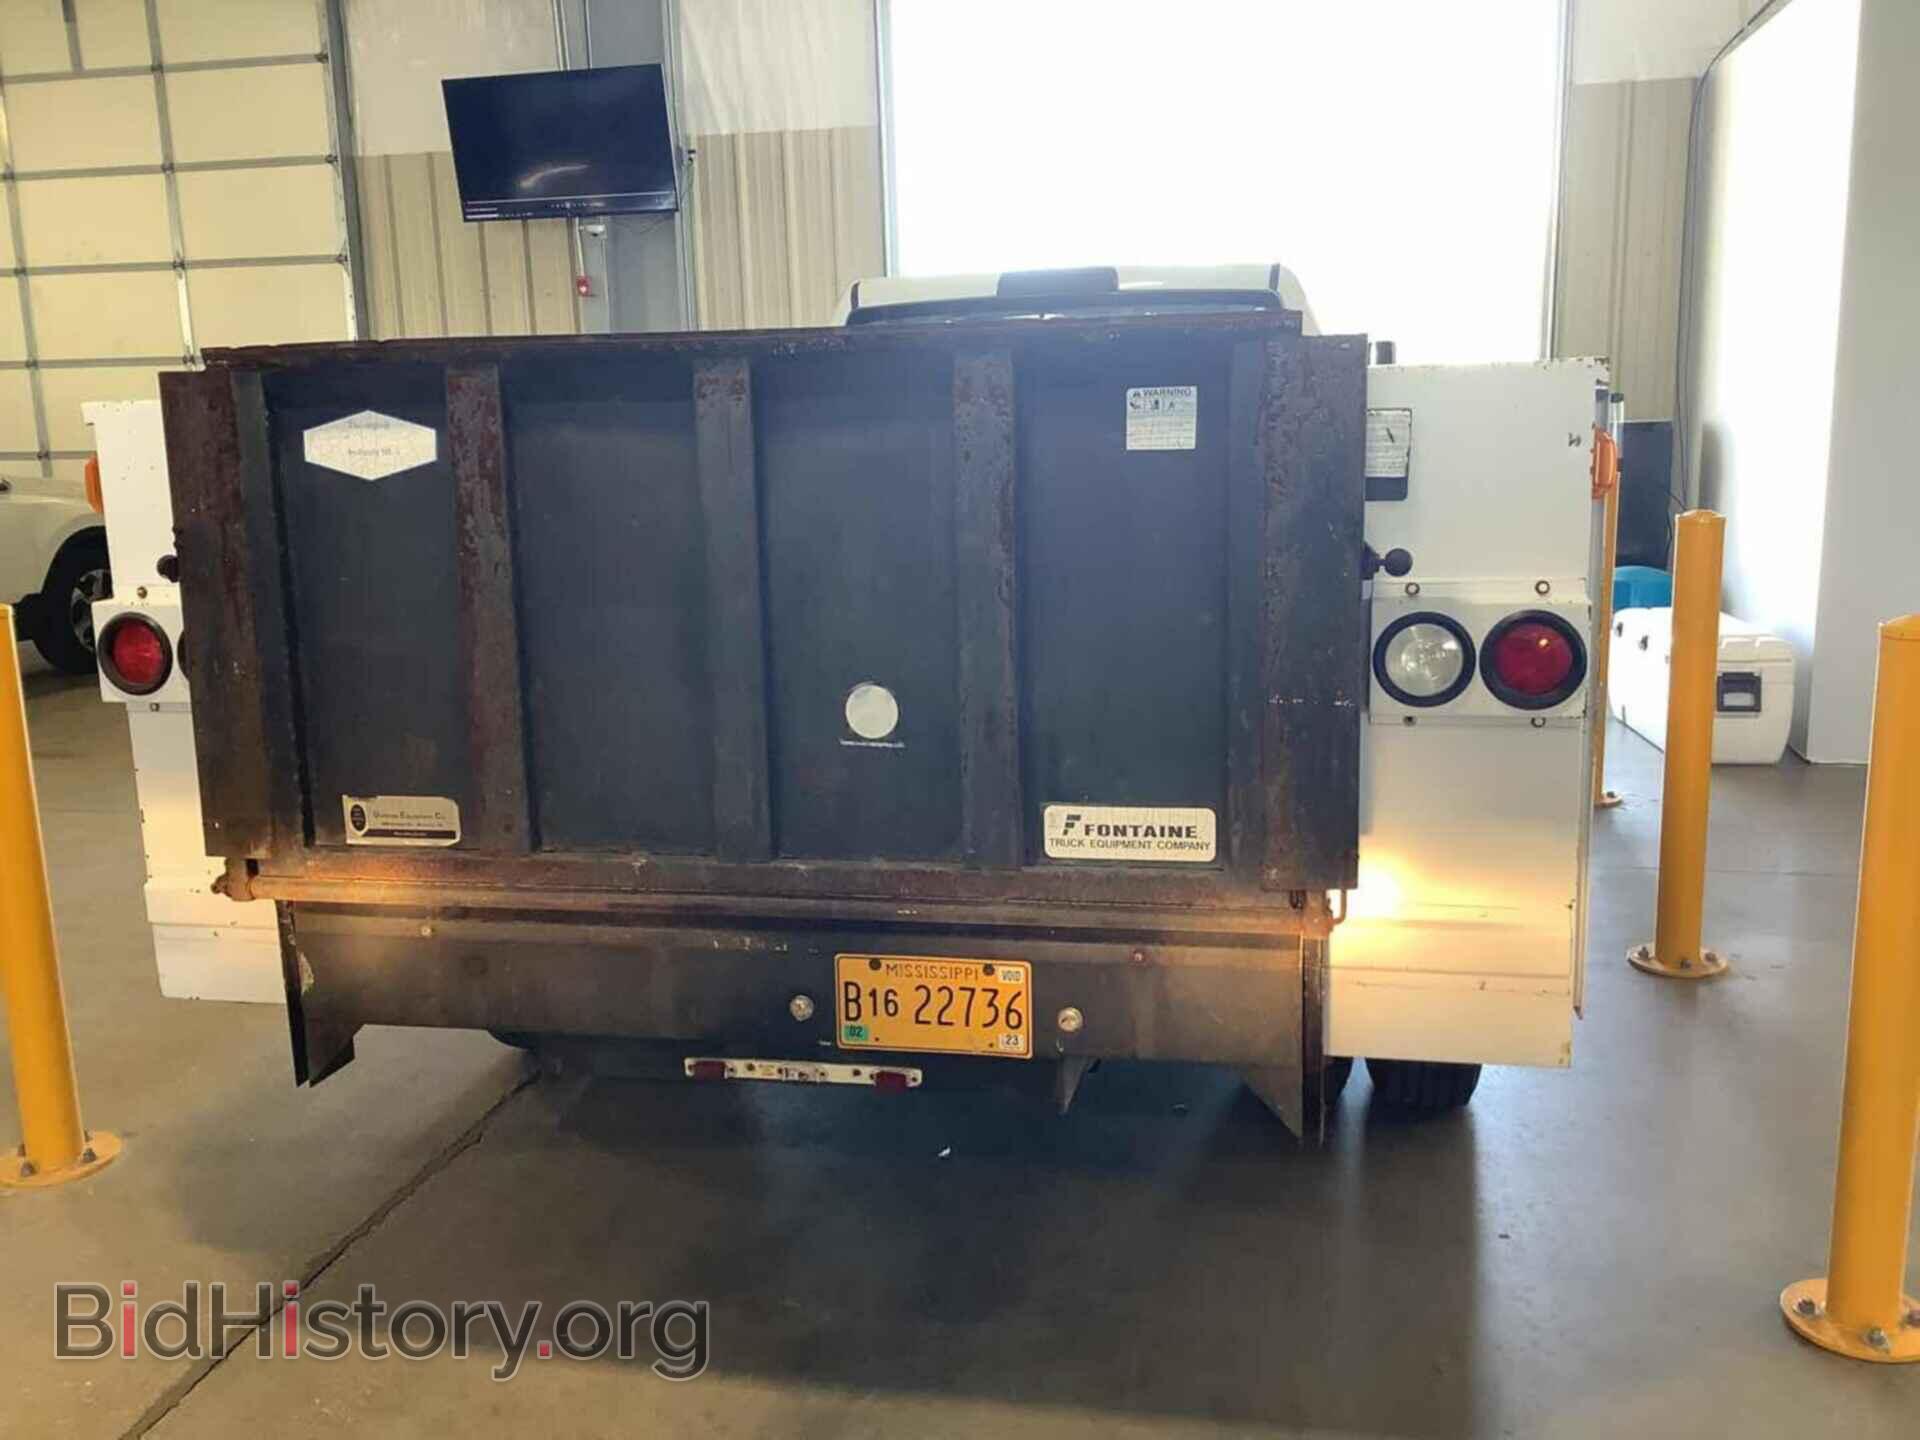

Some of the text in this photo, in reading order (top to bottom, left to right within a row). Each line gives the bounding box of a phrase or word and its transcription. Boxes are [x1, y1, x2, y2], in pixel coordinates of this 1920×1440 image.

[1143, 387, 1192, 399] WARNING
[1084, 824, 1198, 839] FONTAINE
[1049, 838, 1211, 851] TRUCK EQUIPMENT COMPANY
[885, 963, 979, 981] MISSISSIPPI
[914, 984, 1024, 1030] 22736
[1005, 1033, 1020, 1046] 23
